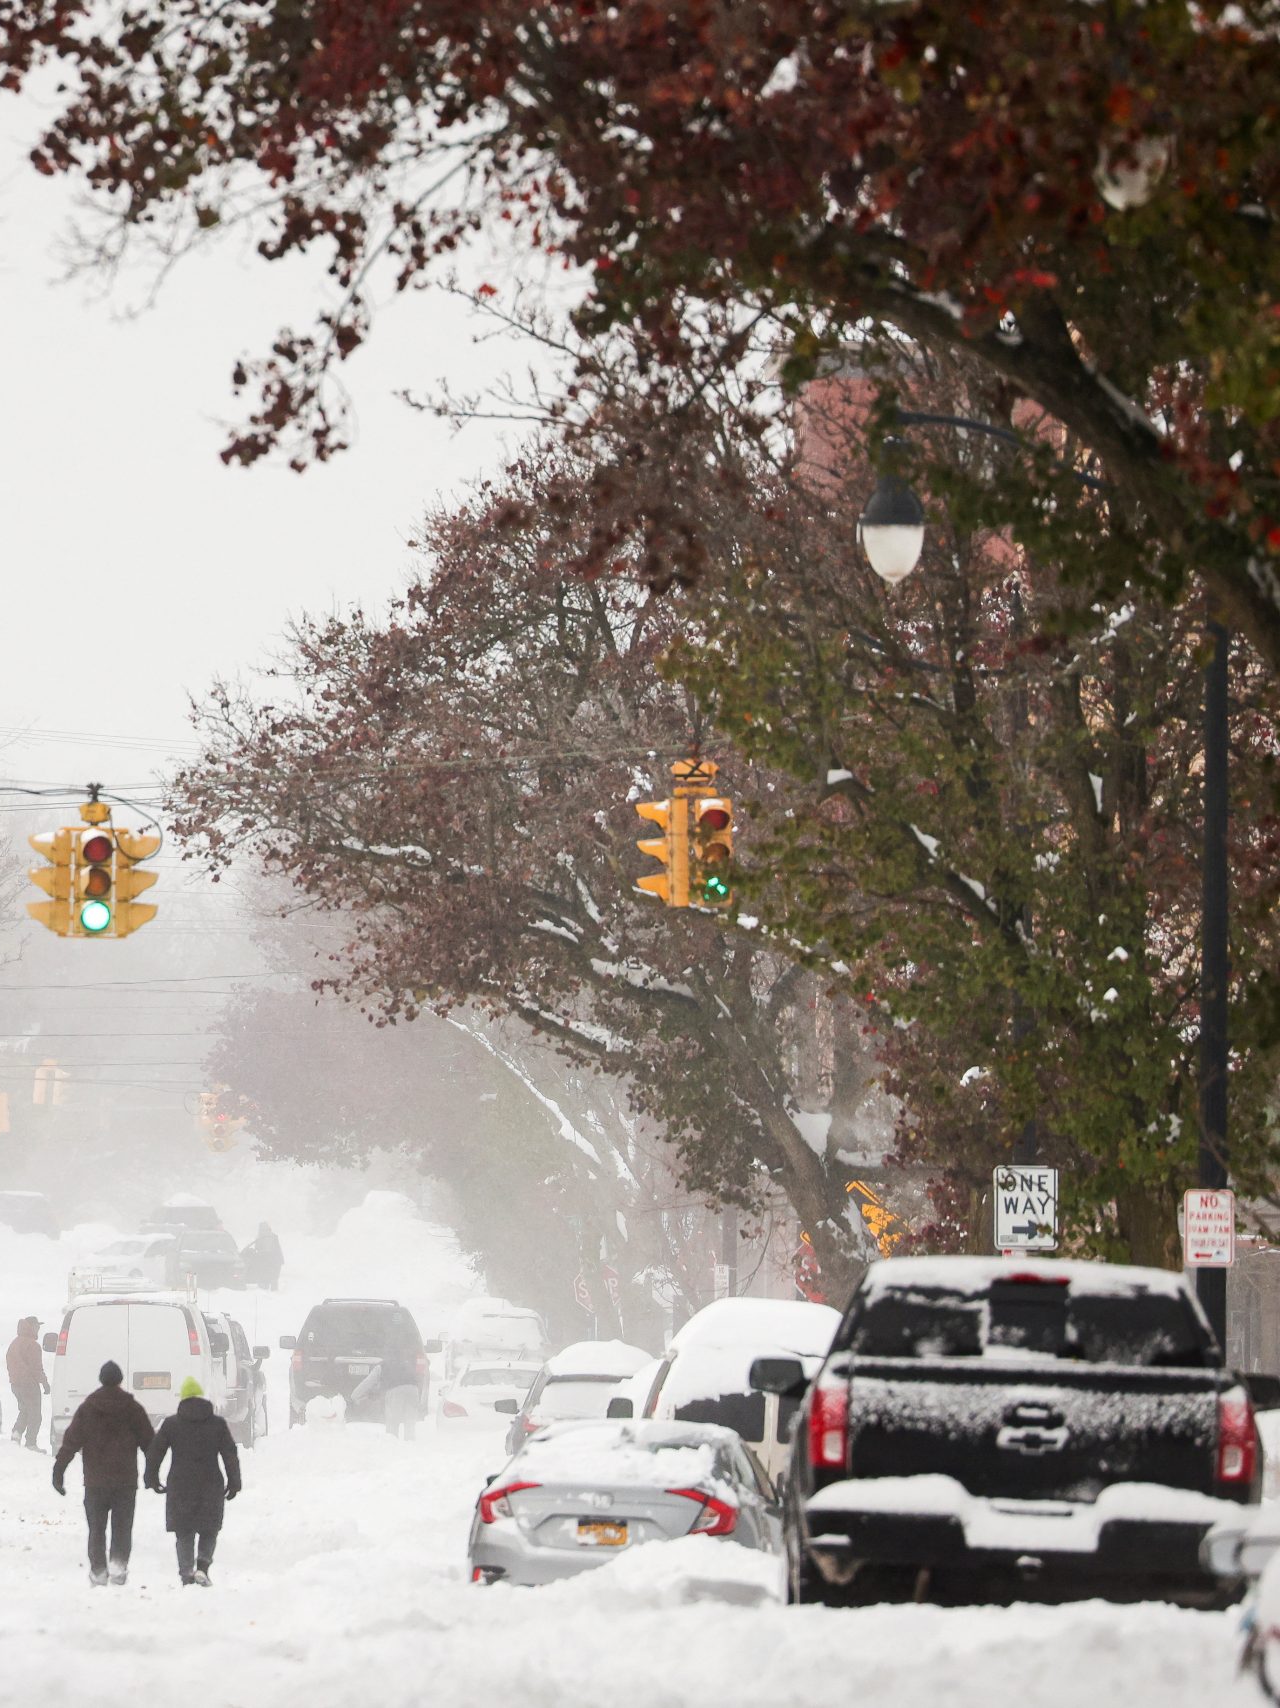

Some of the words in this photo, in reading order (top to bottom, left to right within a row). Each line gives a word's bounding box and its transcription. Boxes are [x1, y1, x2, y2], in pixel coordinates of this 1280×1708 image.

[1005, 1174, 1048, 1192] ONE
[1004, 1196, 1051, 1215] WAY
[1200, 1195, 1218, 1209] NO
[1189, 1211, 1229, 1221] PARKING
